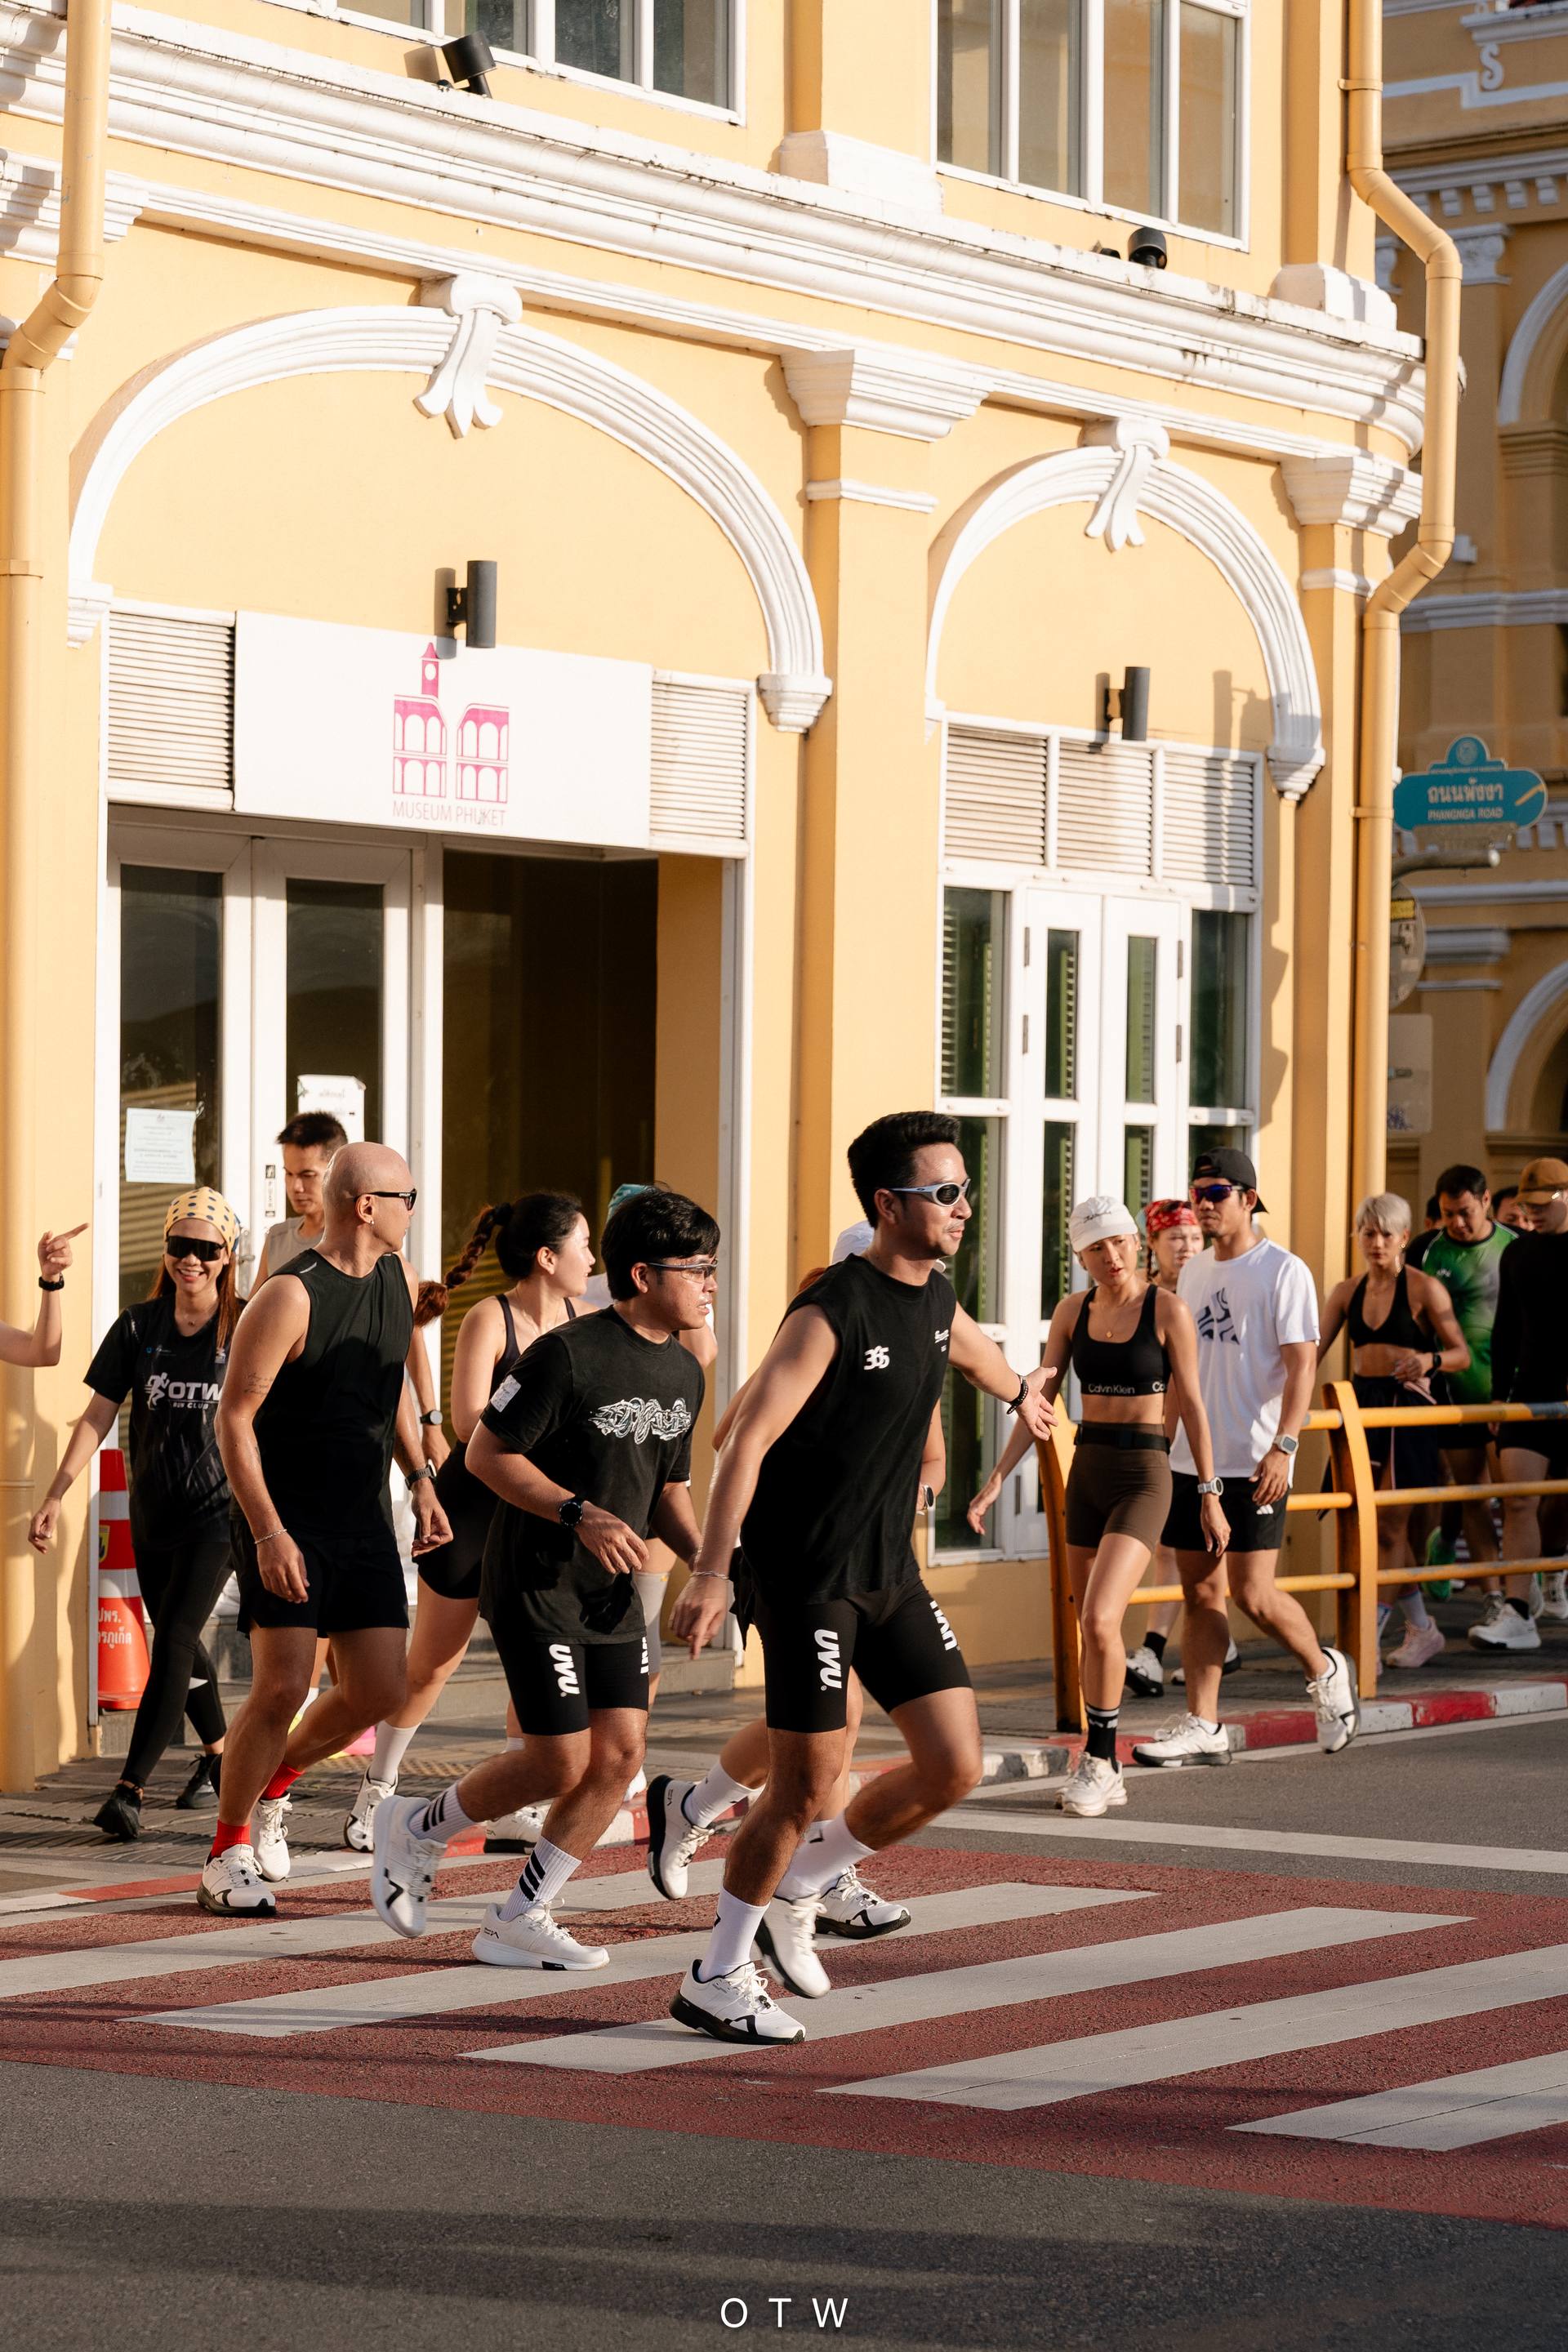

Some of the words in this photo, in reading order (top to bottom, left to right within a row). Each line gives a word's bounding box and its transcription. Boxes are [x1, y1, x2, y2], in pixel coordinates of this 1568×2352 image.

[1428, 777, 1503, 804] ถนนพังงา
[392, 800, 452, 822] MUSEUM
[456, 806, 506, 826] PHUKET
[1477, 807, 1503, 819] ROAD
[167, 1381, 222, 1401] OTW
